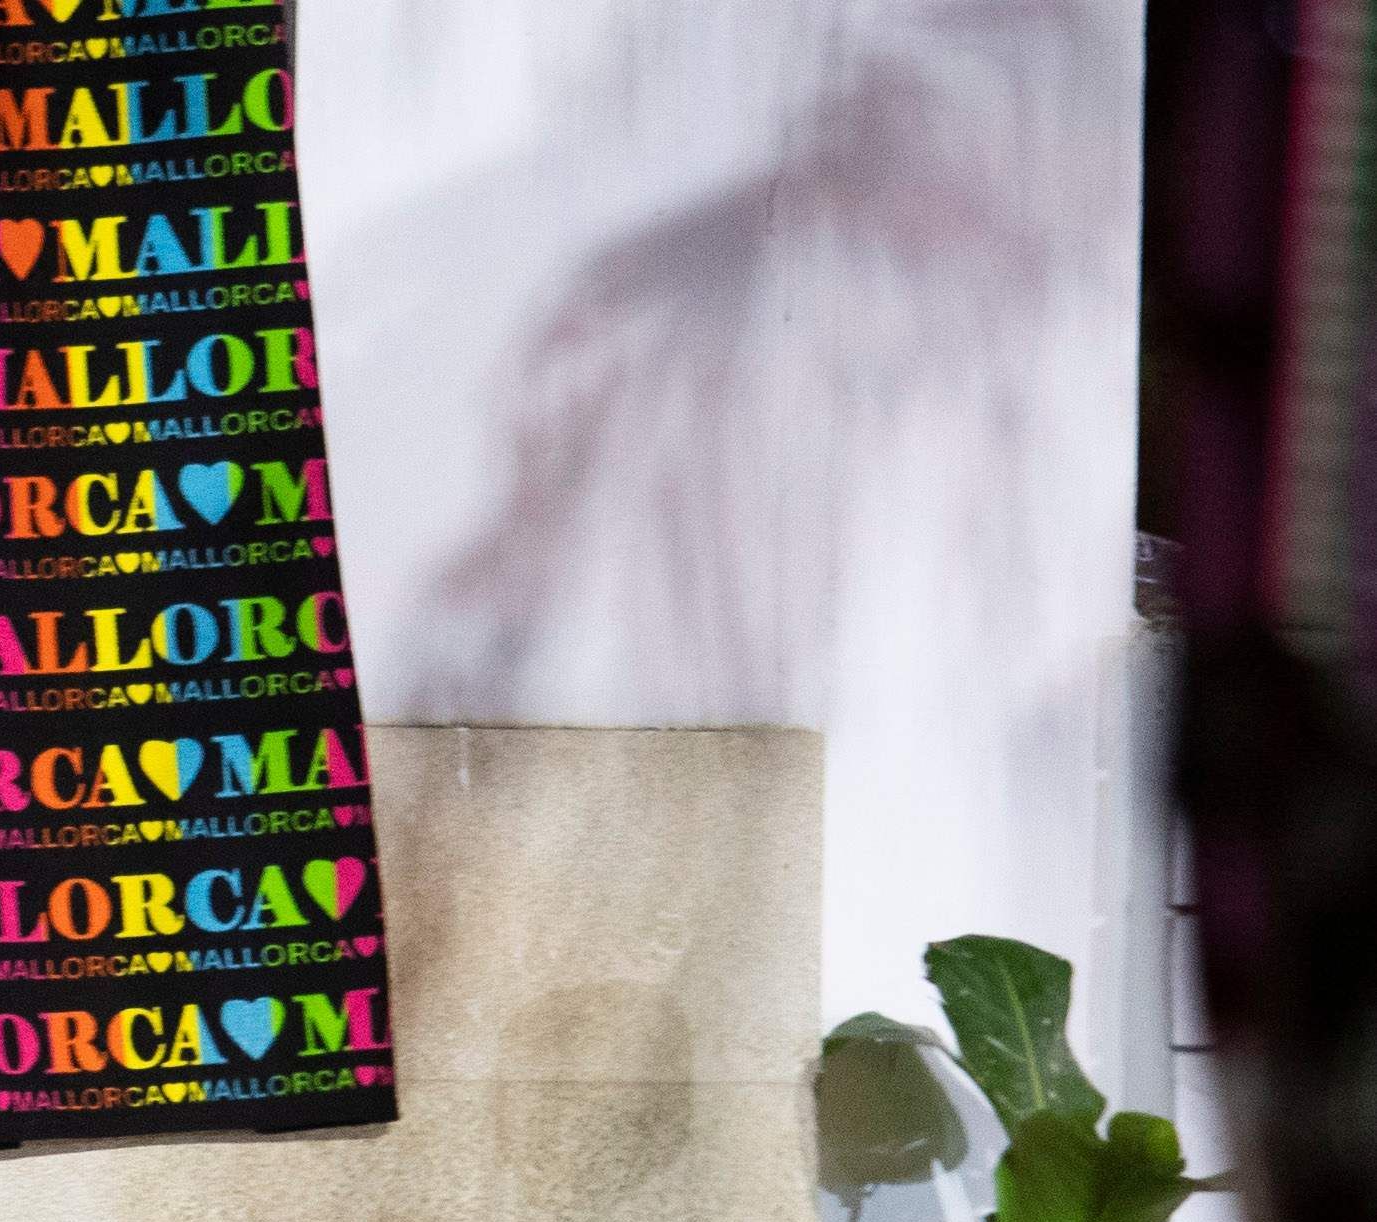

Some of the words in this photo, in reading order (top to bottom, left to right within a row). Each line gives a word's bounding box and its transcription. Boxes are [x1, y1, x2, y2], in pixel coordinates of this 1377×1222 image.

[123, 280, 296, 317] MALLORCA
[141, 538, 313, 574] MALLORCA
[155, 671, 334, 704] MALLORCA
[210, 723, 371, 798] MA
[164, 807, 335, 842] MALLORCA
[174, 939, 356, 972] MALLORCA
[292, 987, 392, 1057] M
[11, 1084, 167, 1112] MALLORCA
[188, 1067, 356, 1103] MALLORCA
